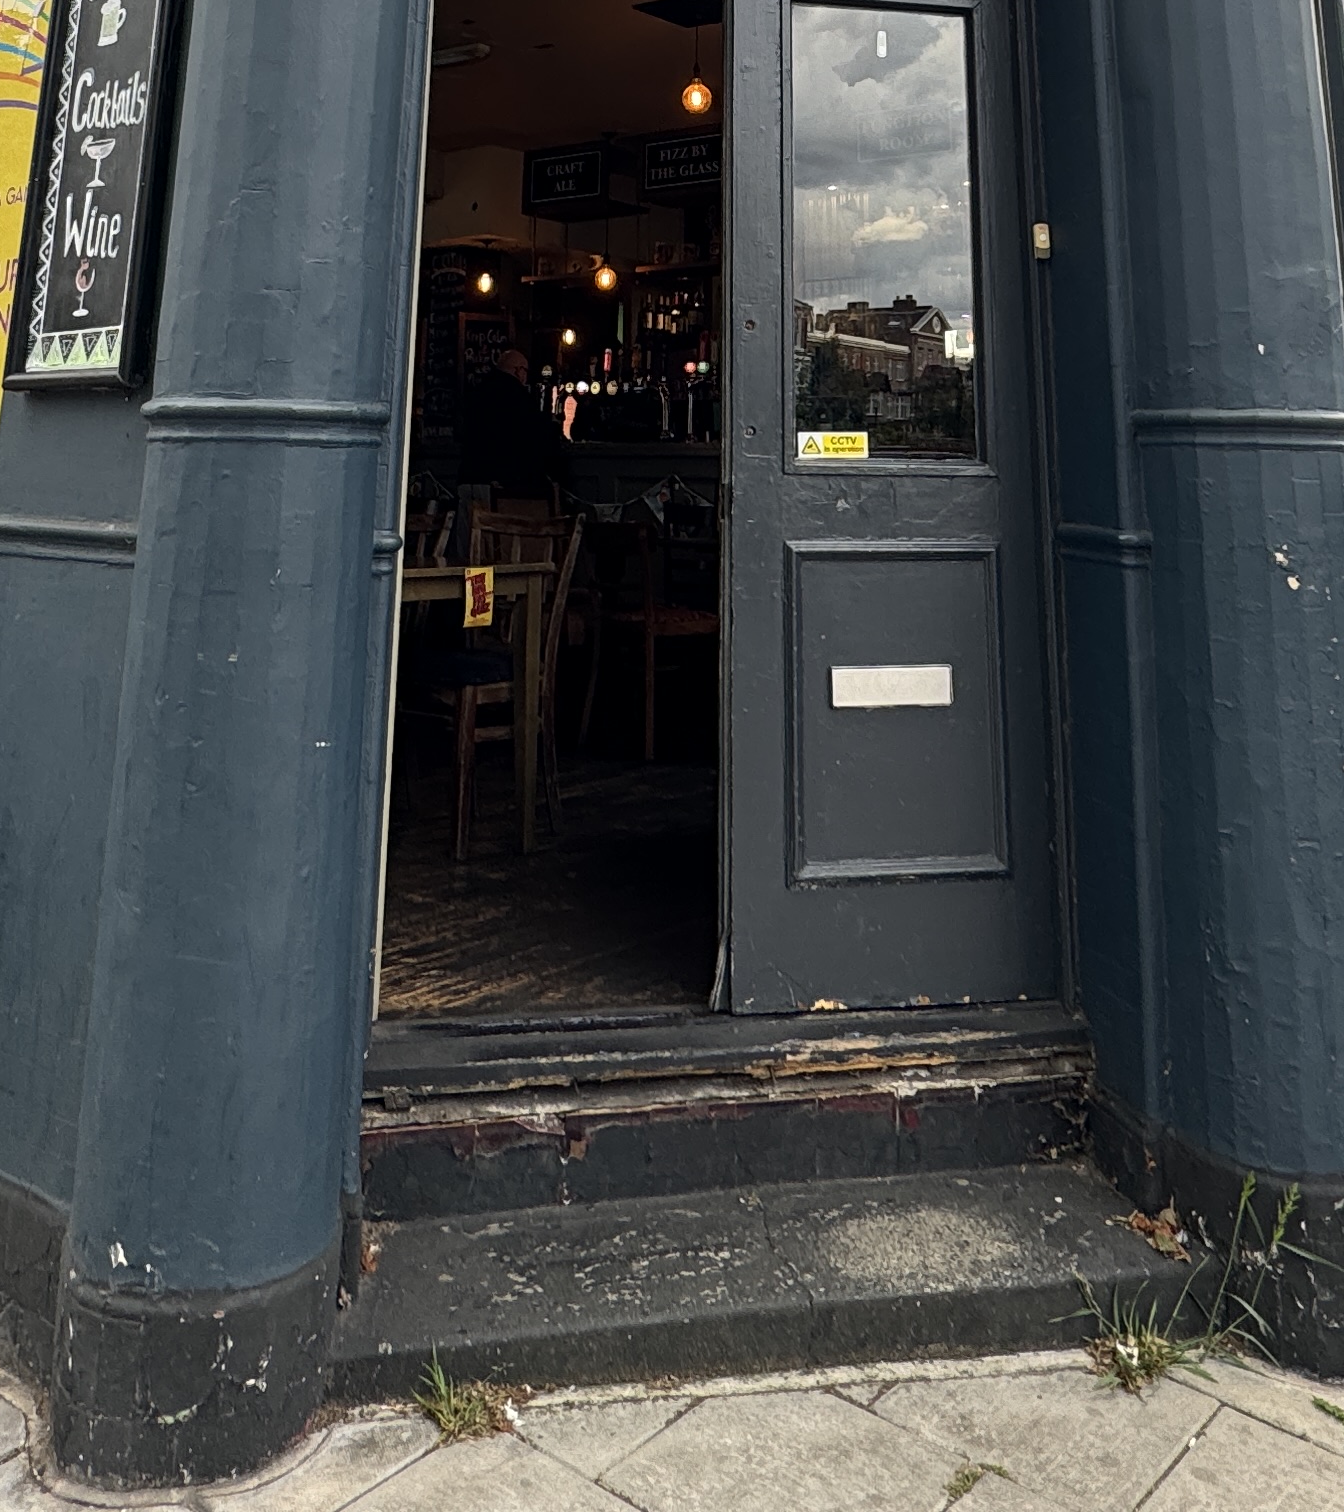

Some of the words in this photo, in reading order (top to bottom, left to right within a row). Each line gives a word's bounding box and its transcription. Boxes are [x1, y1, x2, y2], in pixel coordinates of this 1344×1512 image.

[71, 67, 148, 133] Cocktails
[659, 147, 689, 162] FIZZ
[691, 143, 709, 157] BY
[546, 161, 586, 178] CRAFT
[649, 166, 677, 181] THE
[679, 161, 719, 177] GLASS
[553, 179, 577, 193] ALE
[63, 189, 122, 259] Wine
[830, 436, 858, 445] CCTV
